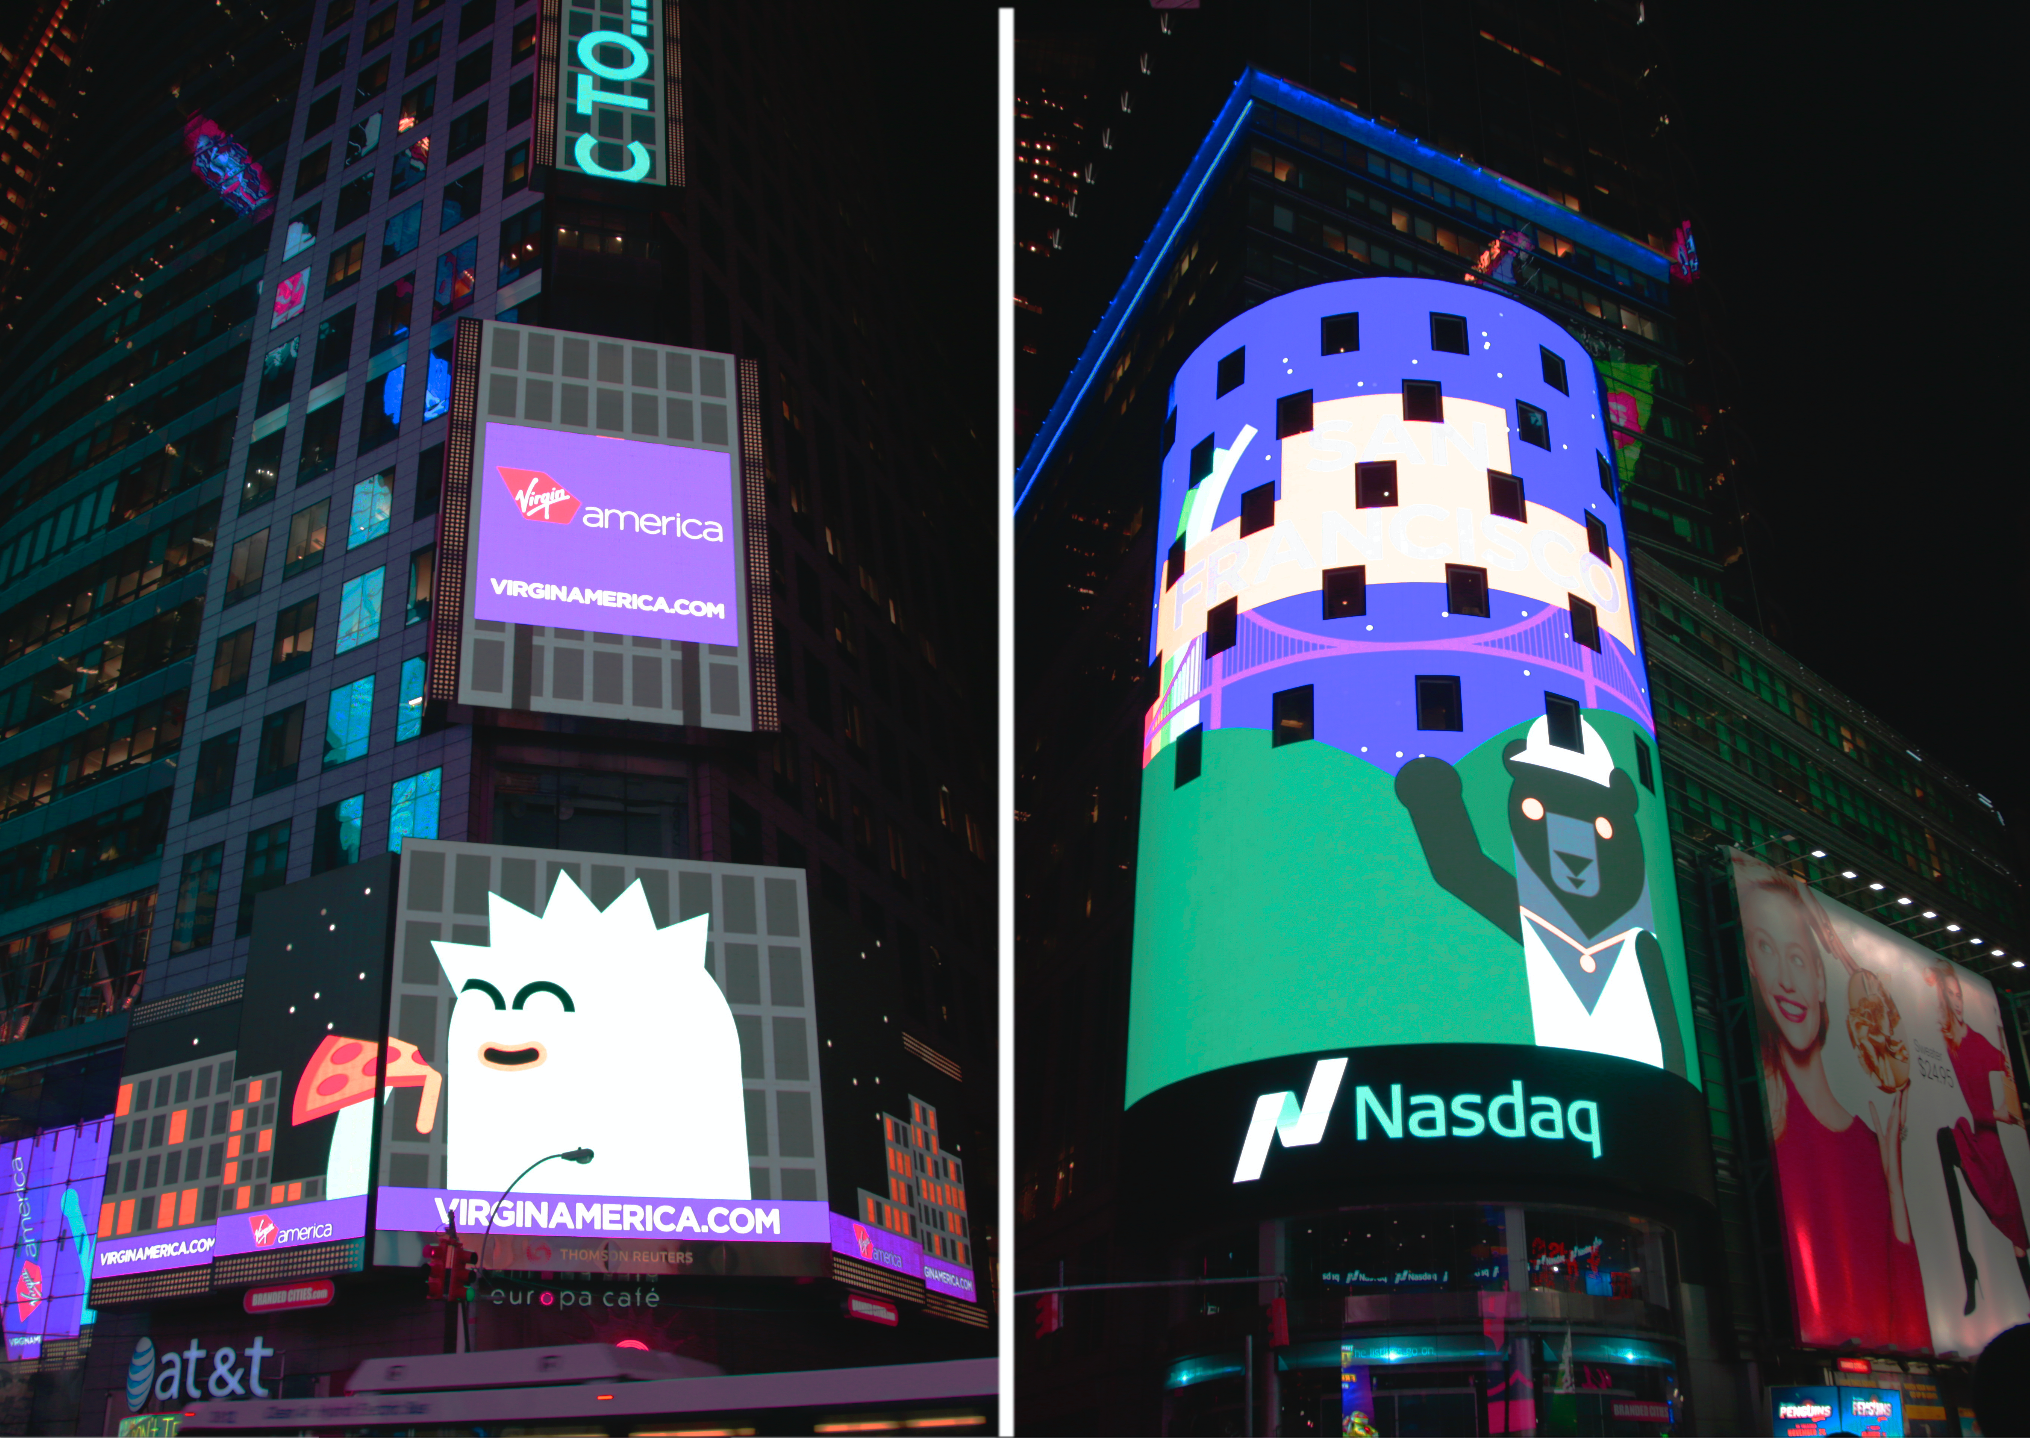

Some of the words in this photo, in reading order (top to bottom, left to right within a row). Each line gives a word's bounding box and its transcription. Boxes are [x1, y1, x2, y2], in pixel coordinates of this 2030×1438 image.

[1307, 413, 1490, 472] SAN
[514, 477, 570, 520] Virgin
[582, 506, 724, 543] america
[1173, 503, 1622, 631] FRANCISCO
[490, 577, 725, 620] VIRGINAMERICA.COM
[1913, 1038, 1943, 1061] Sweater
[1917, 1056, 1955, 1088] $24.95
[1355, 1079, 1603, 1159] Nasdaq
[12, 1156, 38, 1258] america
[433, 1197, 781, 1236] VIRGINAMERICA.COM
[277, 1222, 333, 1244] america
[100, 1237, 216, 1266] VIRGINAMERICA.COM
[560, 1248, 628, 1263] THOMSON
[632, 1250, 694, 1264] REUTERS
[873, 1247, 903, 1268] america
[252, 1290, 287, 1307] BRANDED
[288, 1287, 329, 1302] CITIES.com
[489, 1288, 593, 1311] europa
[602, 1286, 660, 1308] café
[154, 1336, 274, 1402] at&t
[1613, 1403, 1649, 1417] BRANDED
[1779, 1404, 1833, 1419] PENGUINS
